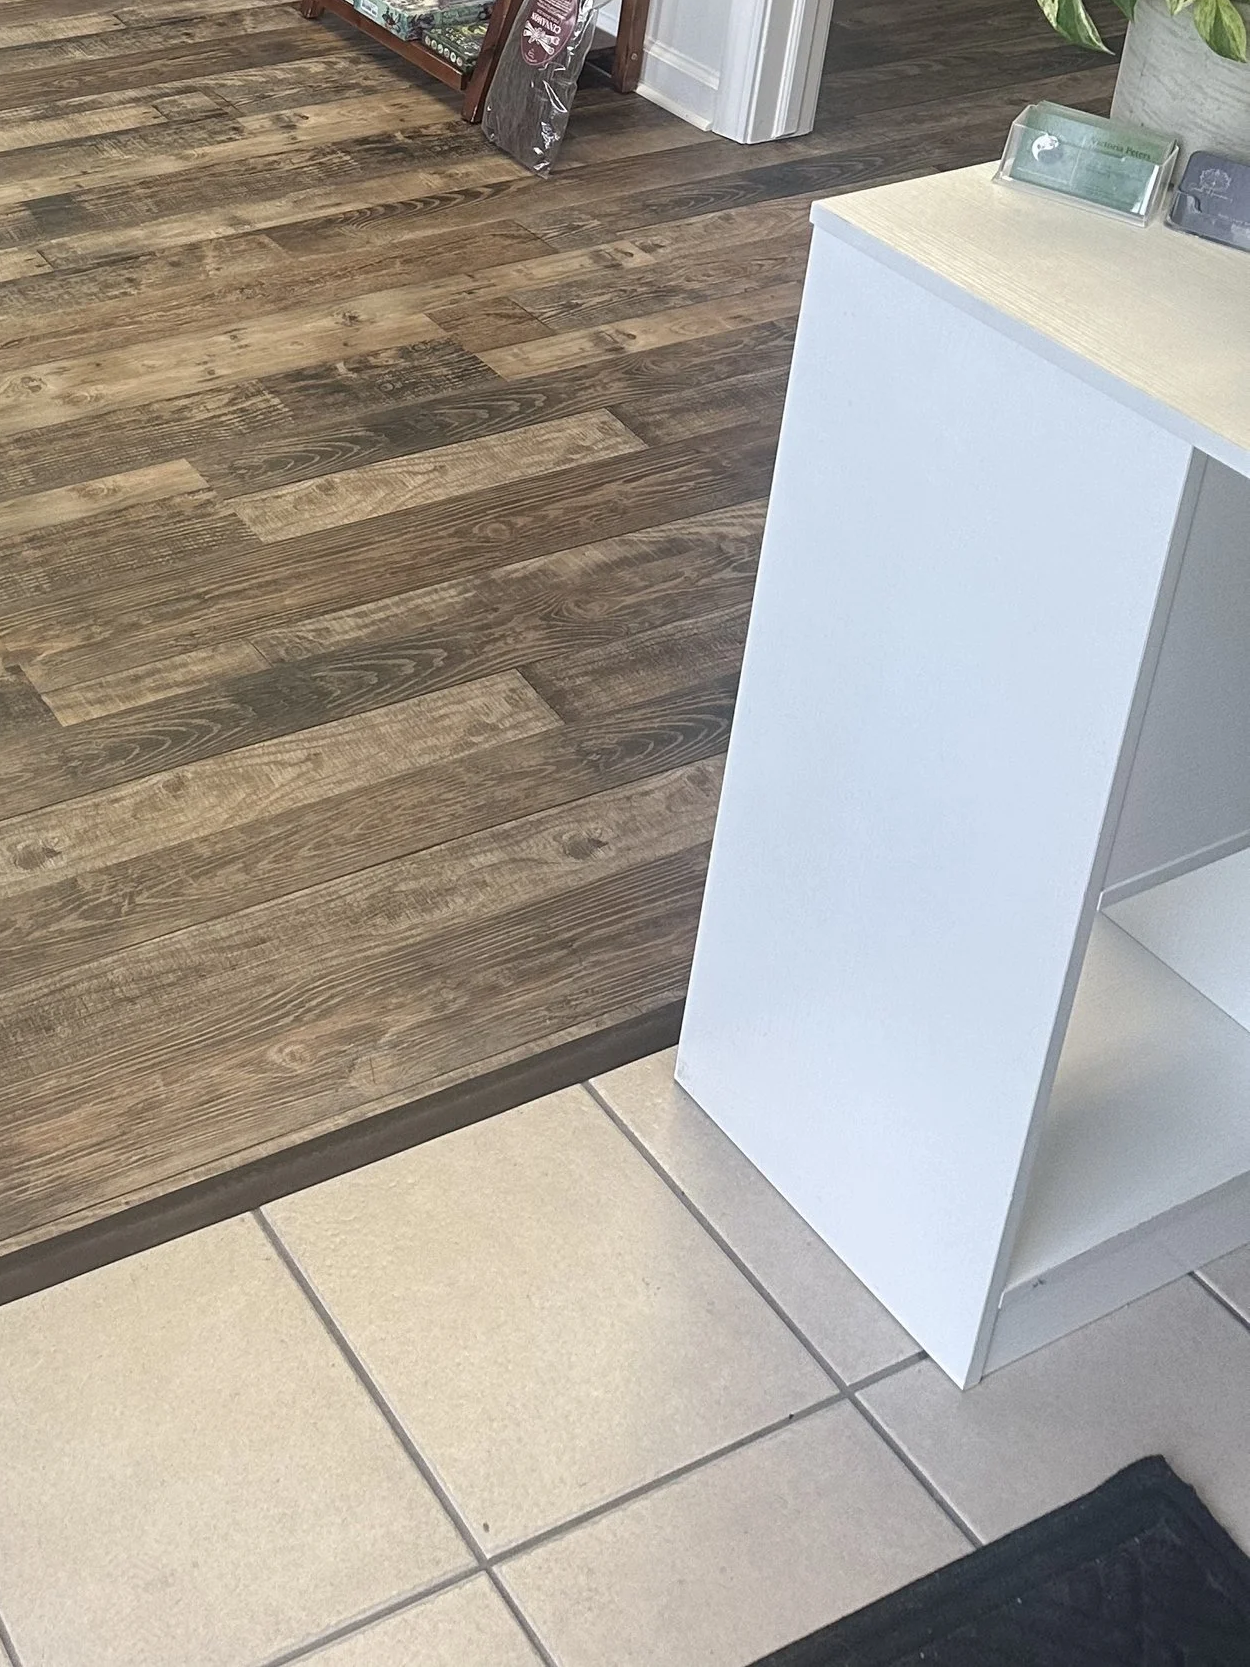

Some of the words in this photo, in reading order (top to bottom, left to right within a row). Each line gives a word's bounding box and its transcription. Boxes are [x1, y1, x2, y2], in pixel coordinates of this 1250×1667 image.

[531, 12, 562, 35] CINNAMON
[1091, 139, 1124, 153] Victoria
[1125, 146, 1152, 161] Peters
